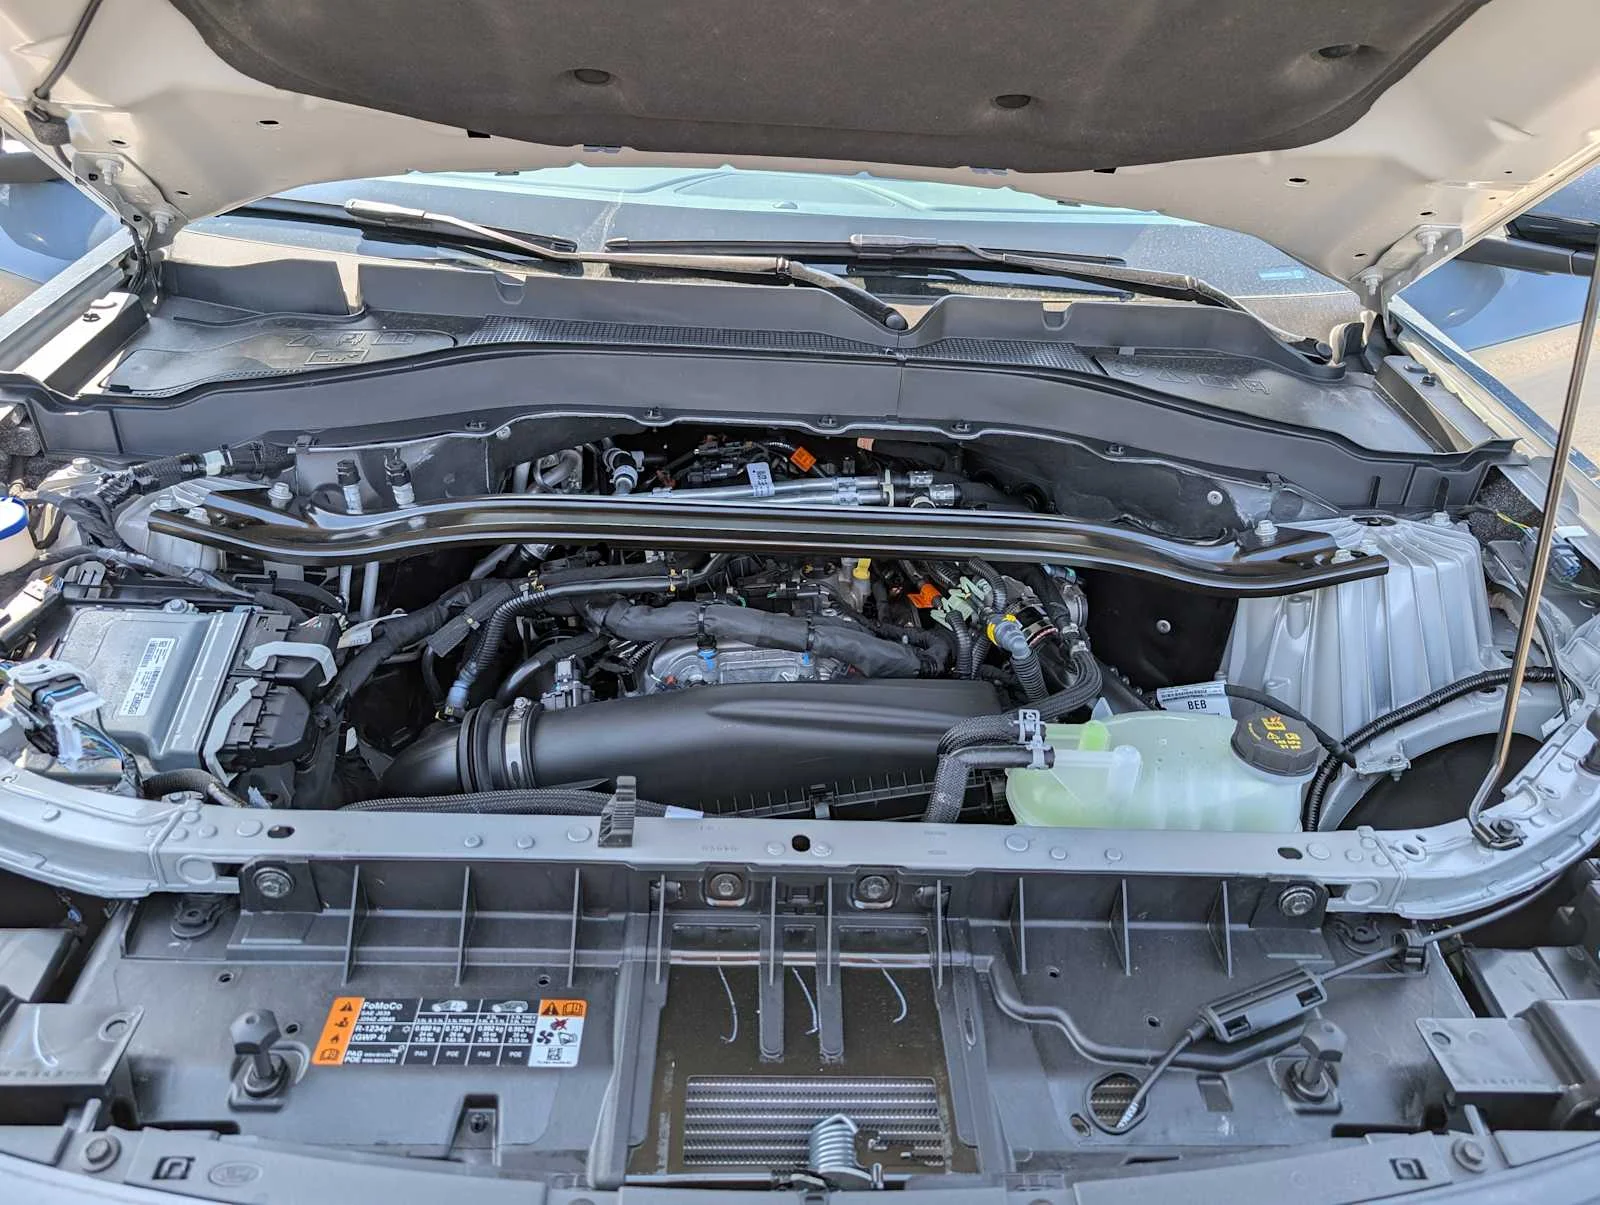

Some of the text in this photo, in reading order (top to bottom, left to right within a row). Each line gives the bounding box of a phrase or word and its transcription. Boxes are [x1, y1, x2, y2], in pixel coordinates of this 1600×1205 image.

[1187, 699, 1207, 710] BEB
[363, 1002, 403, 1010] FoMoCo
[355, 1025, 393, 1033] R-1234yf
[351, 1034, 387, 1042] (GWP 4)
